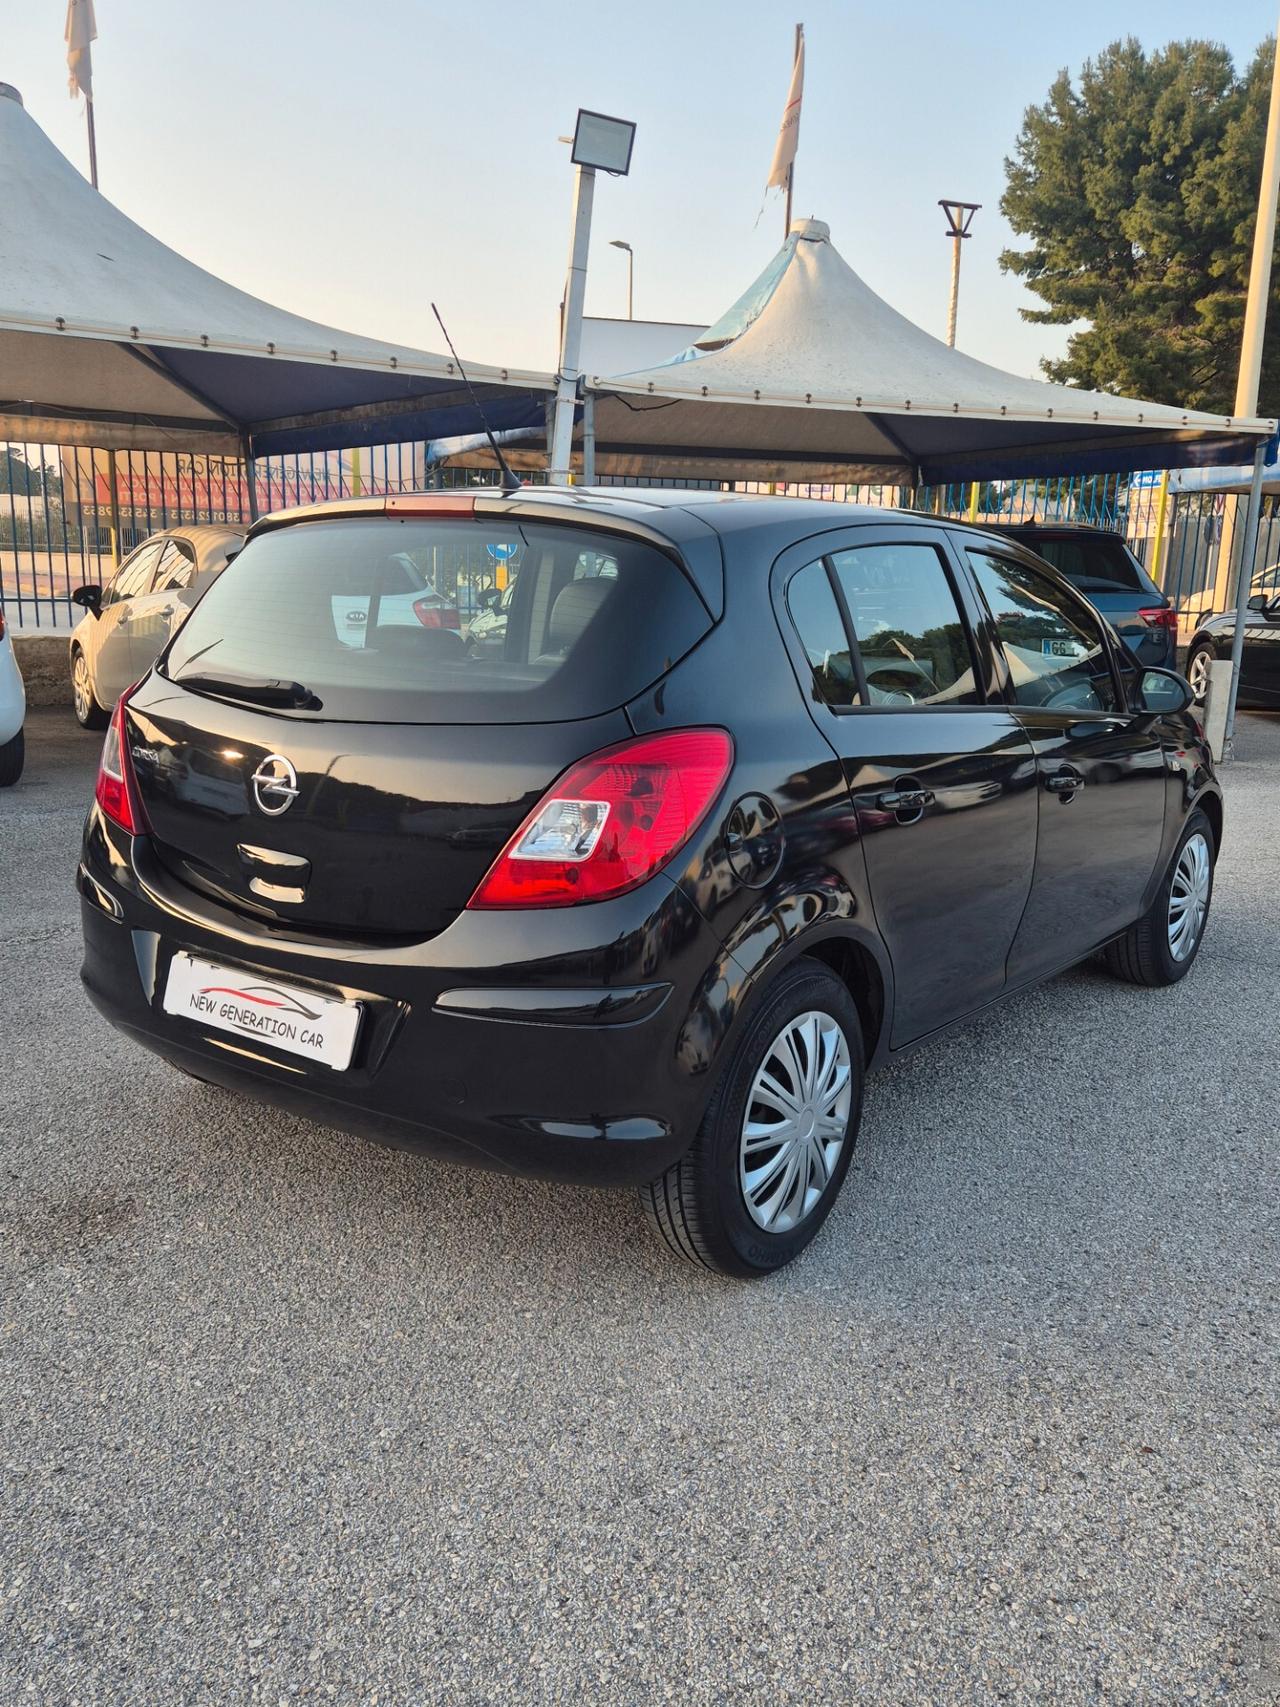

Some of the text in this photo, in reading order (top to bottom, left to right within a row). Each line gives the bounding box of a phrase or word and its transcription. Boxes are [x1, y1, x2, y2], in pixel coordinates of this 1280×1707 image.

[189, 993, 324, 1049] NEW GENERATION CAR
